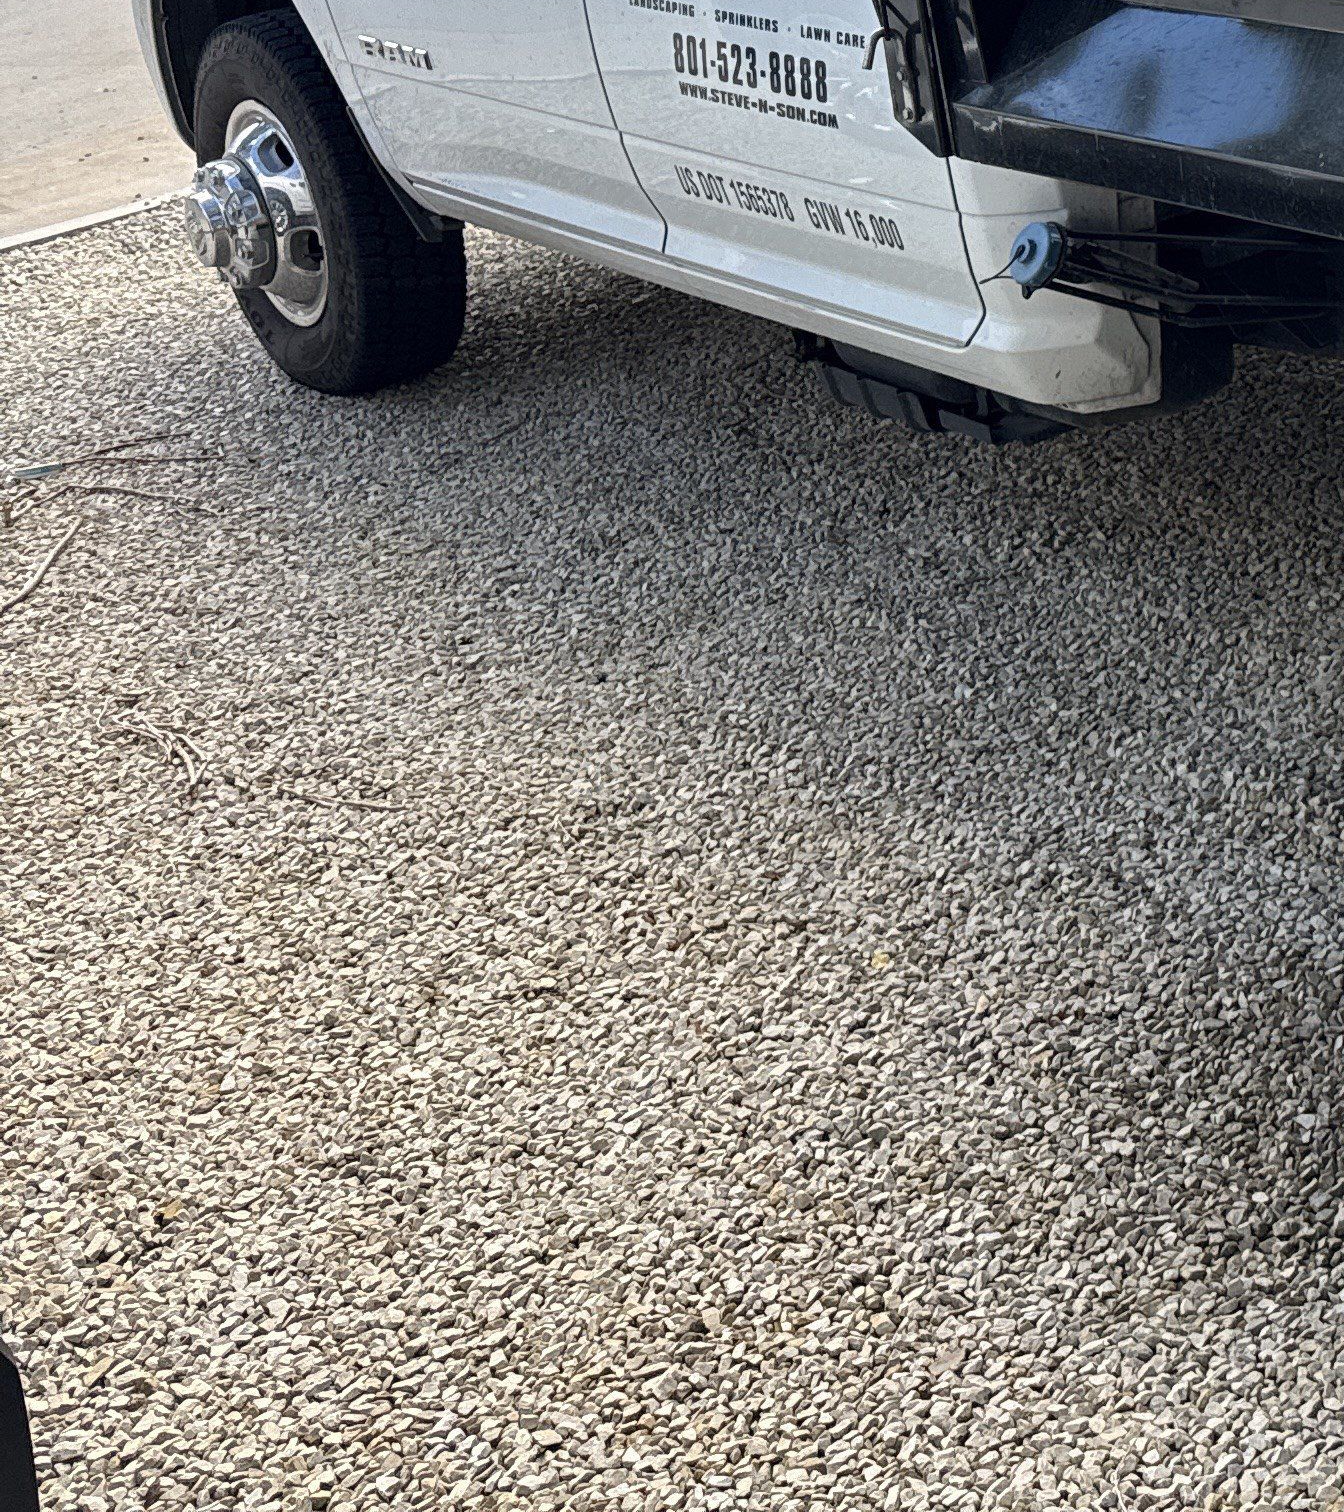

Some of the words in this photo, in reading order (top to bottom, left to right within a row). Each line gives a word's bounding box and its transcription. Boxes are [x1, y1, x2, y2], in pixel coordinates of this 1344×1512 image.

[357, 34, 433, 70] RAM
[714, 9, 778, 33] SPRINKLERS
[800, 24, 831, 43] LAWN
[836, 30, 866, 49] CARE
[672, 32, 828, 103] 801-523-8888
[679, 80, 839, 129] WWW.STEVE-N-SON.COM
[674, 164, 701, 198] US
[696, 170, 731, 206] DOT
[729, 178, 795, 222] 1565378
[804, 197, 846, 236] GVW
[845, 207, 905, 250] 16,000
